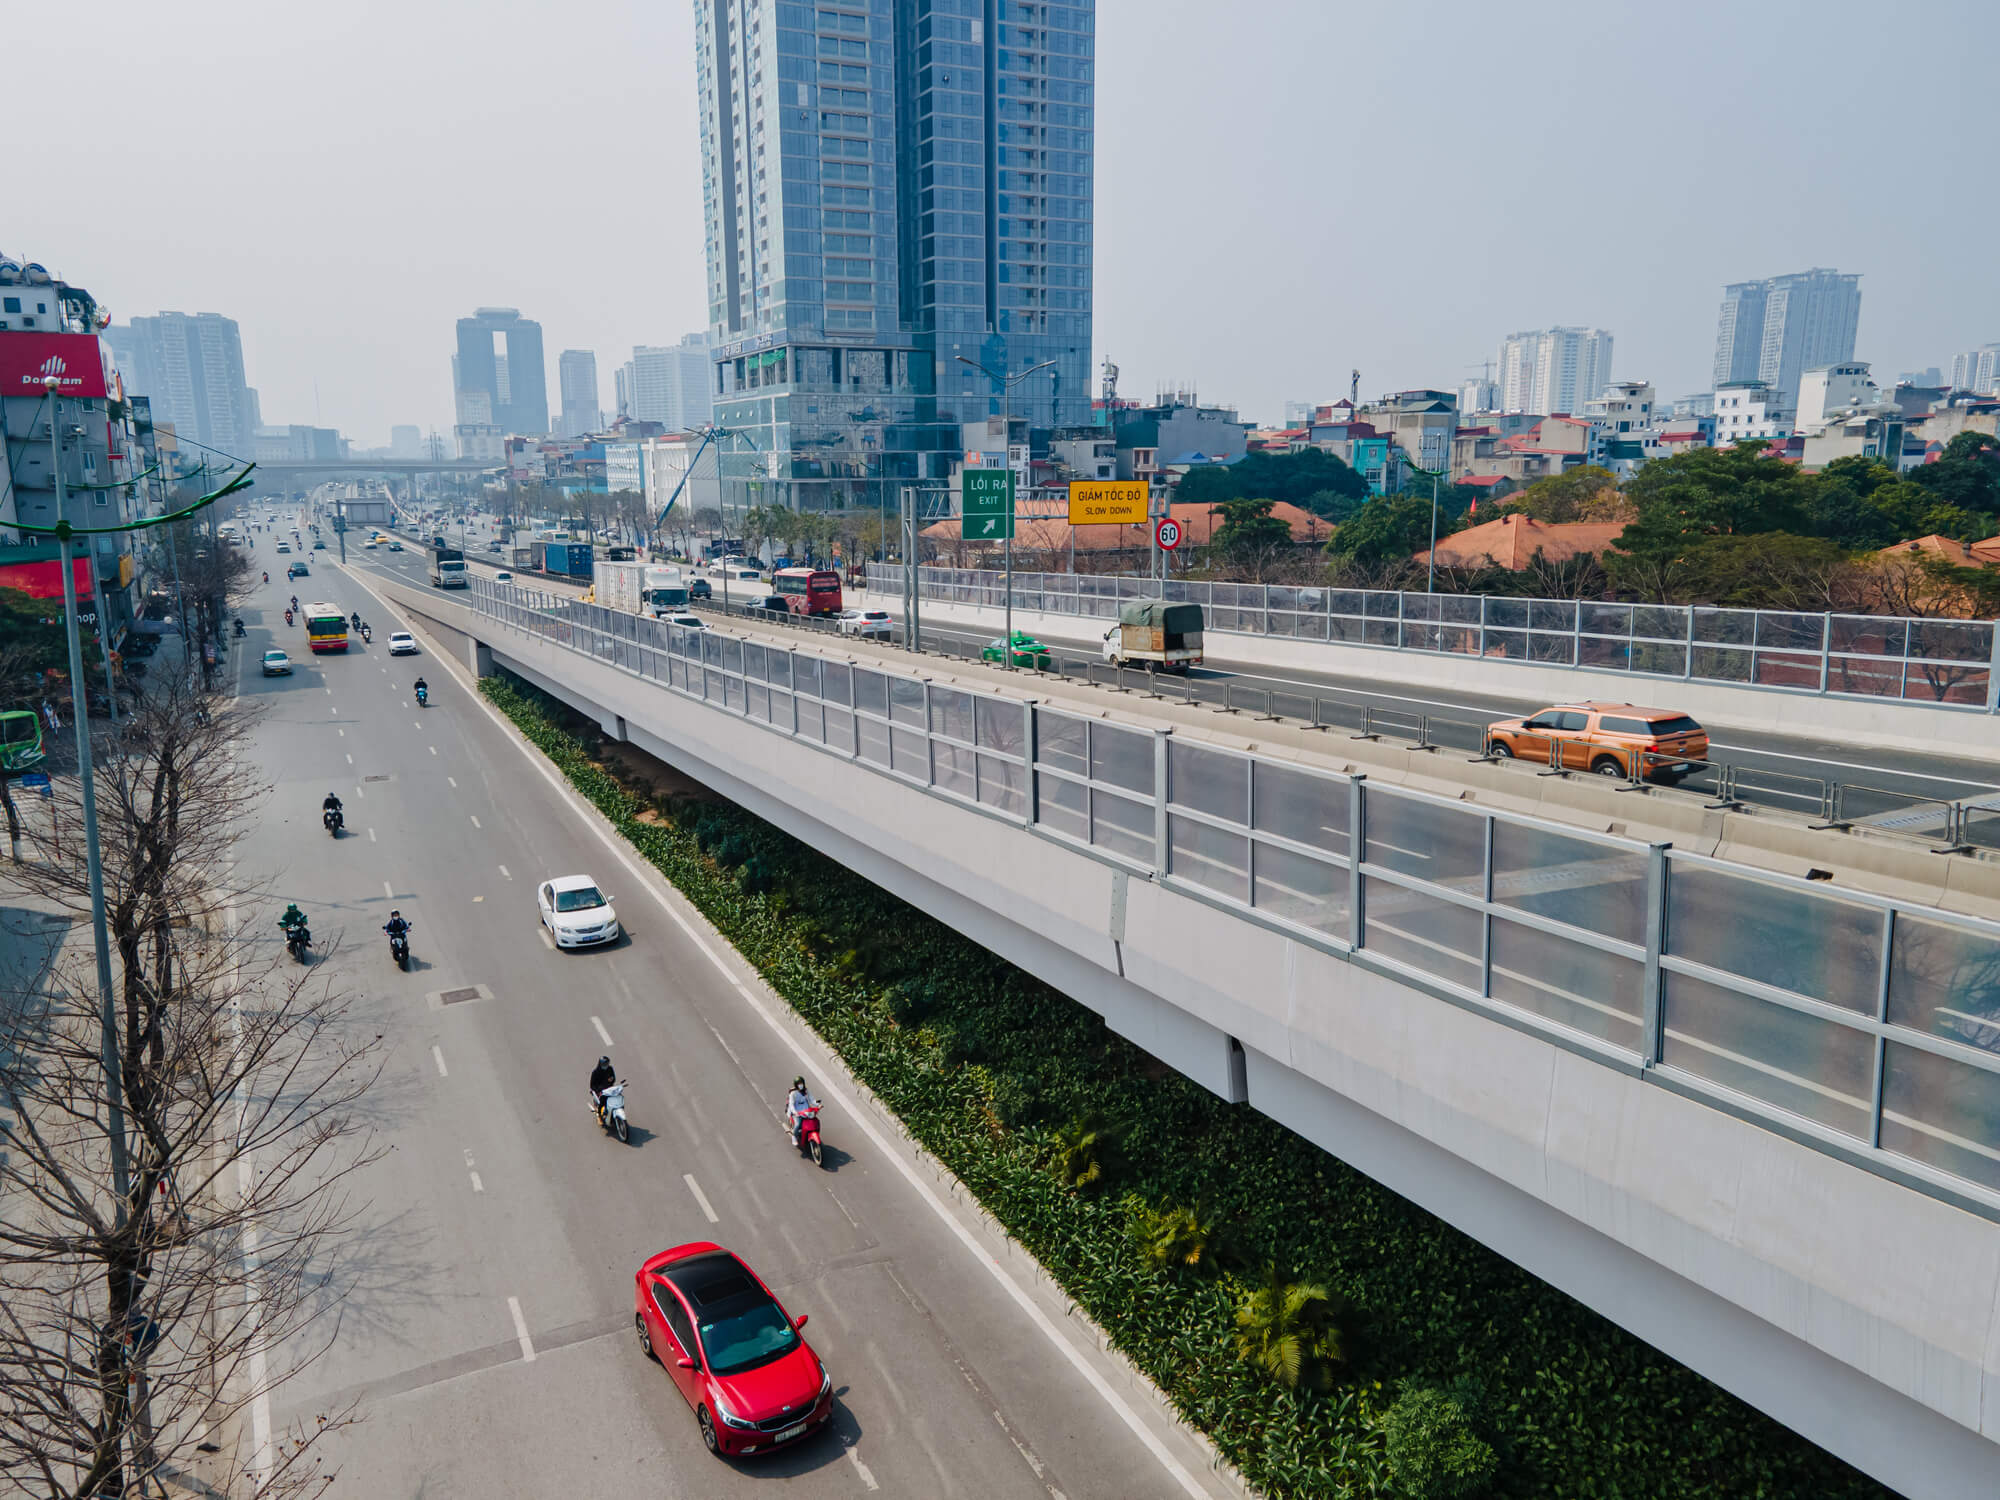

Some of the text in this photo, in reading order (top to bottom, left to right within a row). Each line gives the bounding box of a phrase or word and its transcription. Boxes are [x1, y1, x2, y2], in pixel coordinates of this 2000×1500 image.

[992, 479, 1008, 490] RA
[979, 496, 998, 504] EXIT
[1085, 506, 1132, 515] SLOW DOWN
[1161, 527, 1176, 541] 60
